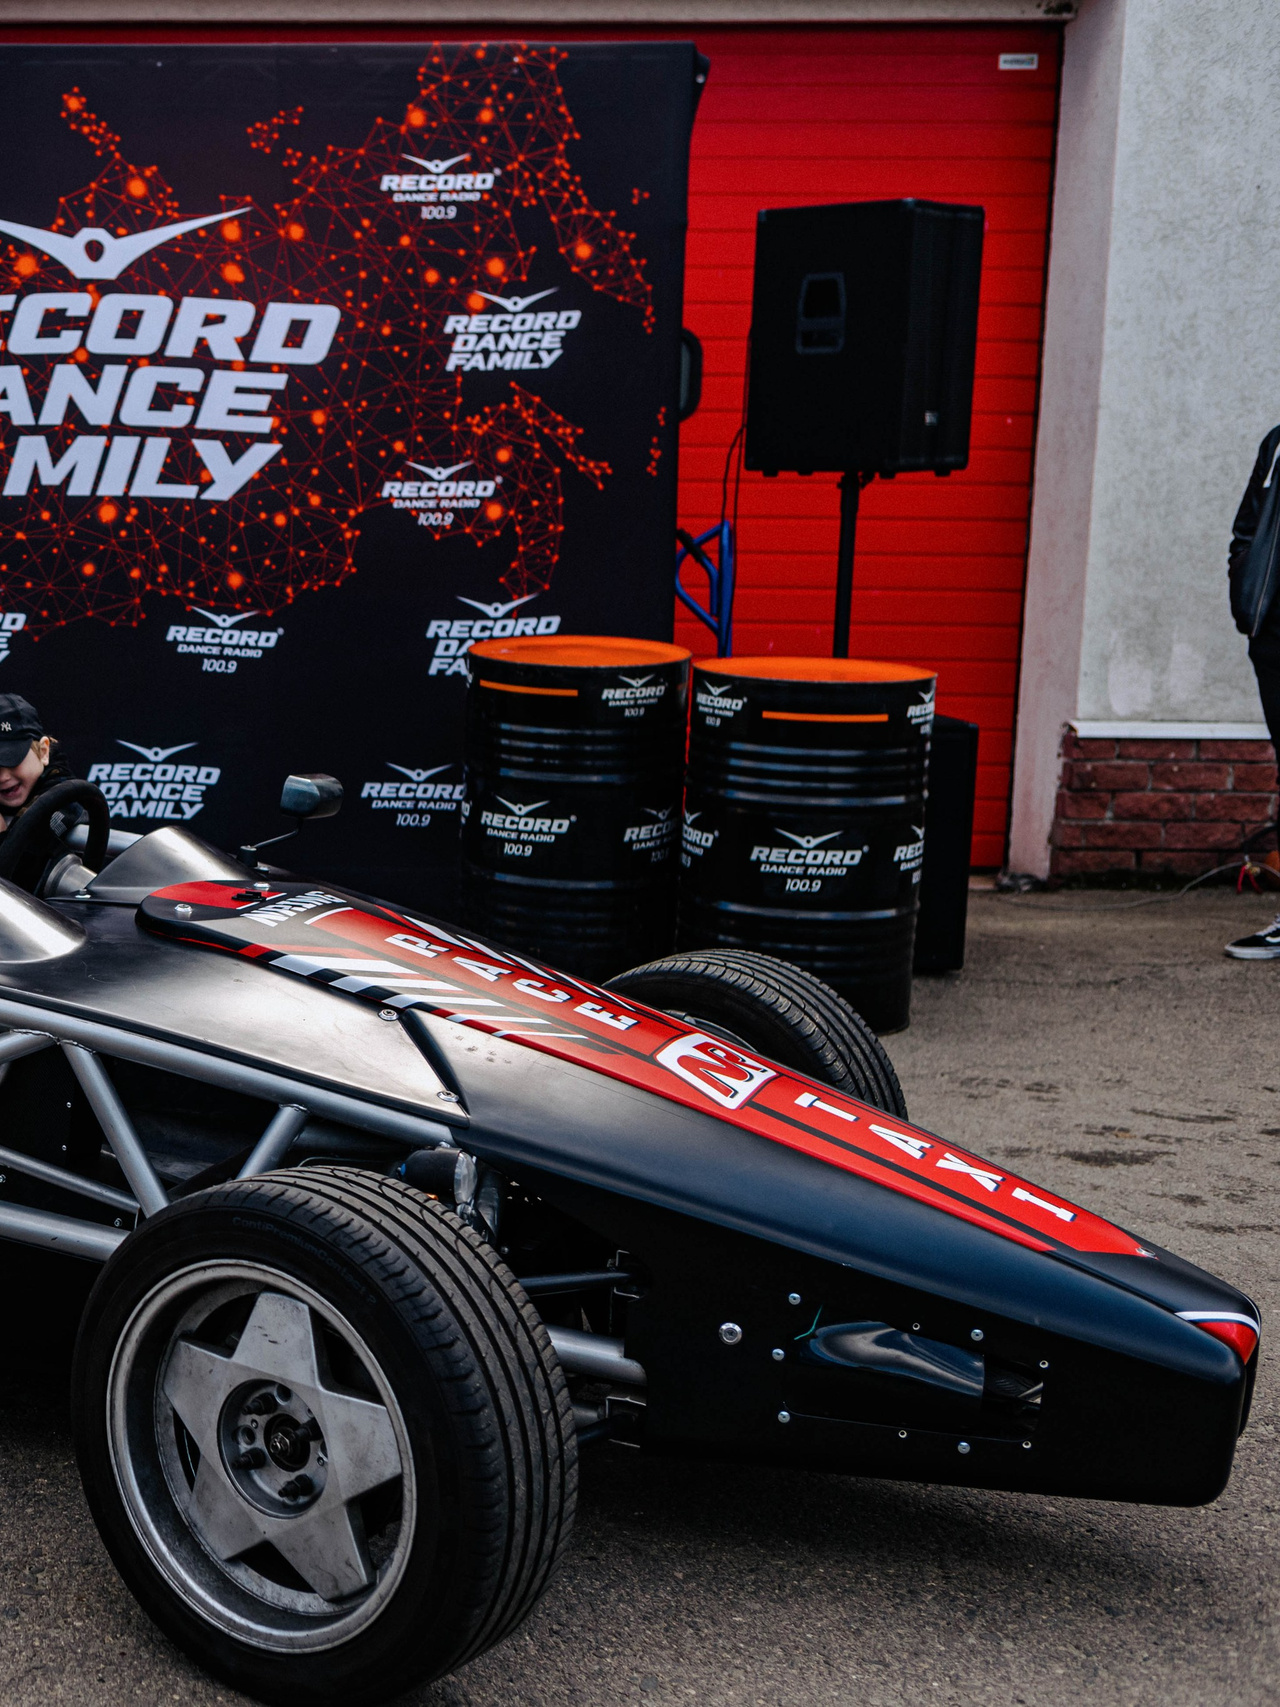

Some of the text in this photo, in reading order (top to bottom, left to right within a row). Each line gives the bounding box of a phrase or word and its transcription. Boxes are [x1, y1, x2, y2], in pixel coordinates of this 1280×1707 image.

[380, 173, 495, 191] RECORD
[392, 191, 482, 203] DANCE RADIO
[420, 205, 458, 220] 100.9
[443, 310, 582, 334] RECORD
[453, 330, 566, 352] DANCE
[445, 349, 564, 371] FAMILY
[381, 480, 496, 498] RECORD
[392, 498, 481, 509] DANCE RADIO
[417, 511, 455, 527] 100.9
[425, 615, 561, 639] RECORD
[166, 625, 279, 648] RECORD
[177, 643, 263, 658] DANCE RADIO
[201, 658, 238, 673] 100.9
[601, 685, 665, 701] RECORD
[86, 763, 221, 785] RECORD
[99, 781, 207, 802] DANCE
[371, 799, 457, 811] DANCE RADIO
[395, 812, 431, 827] 100.9
[480, 811, 570, 834] RECORD
[486, 828, 555, 843] DANCE RADIO
[503, 842, 533, 857] 100.9
[749, 845, 863, 866] RECORD
[760, 863, 848, 877] DANCE RADIO
[785, 878, 822, 893] 100.9
[383, 932, 642, 1031] RACE
[793, 1091, 1079, 1224] TAXI
